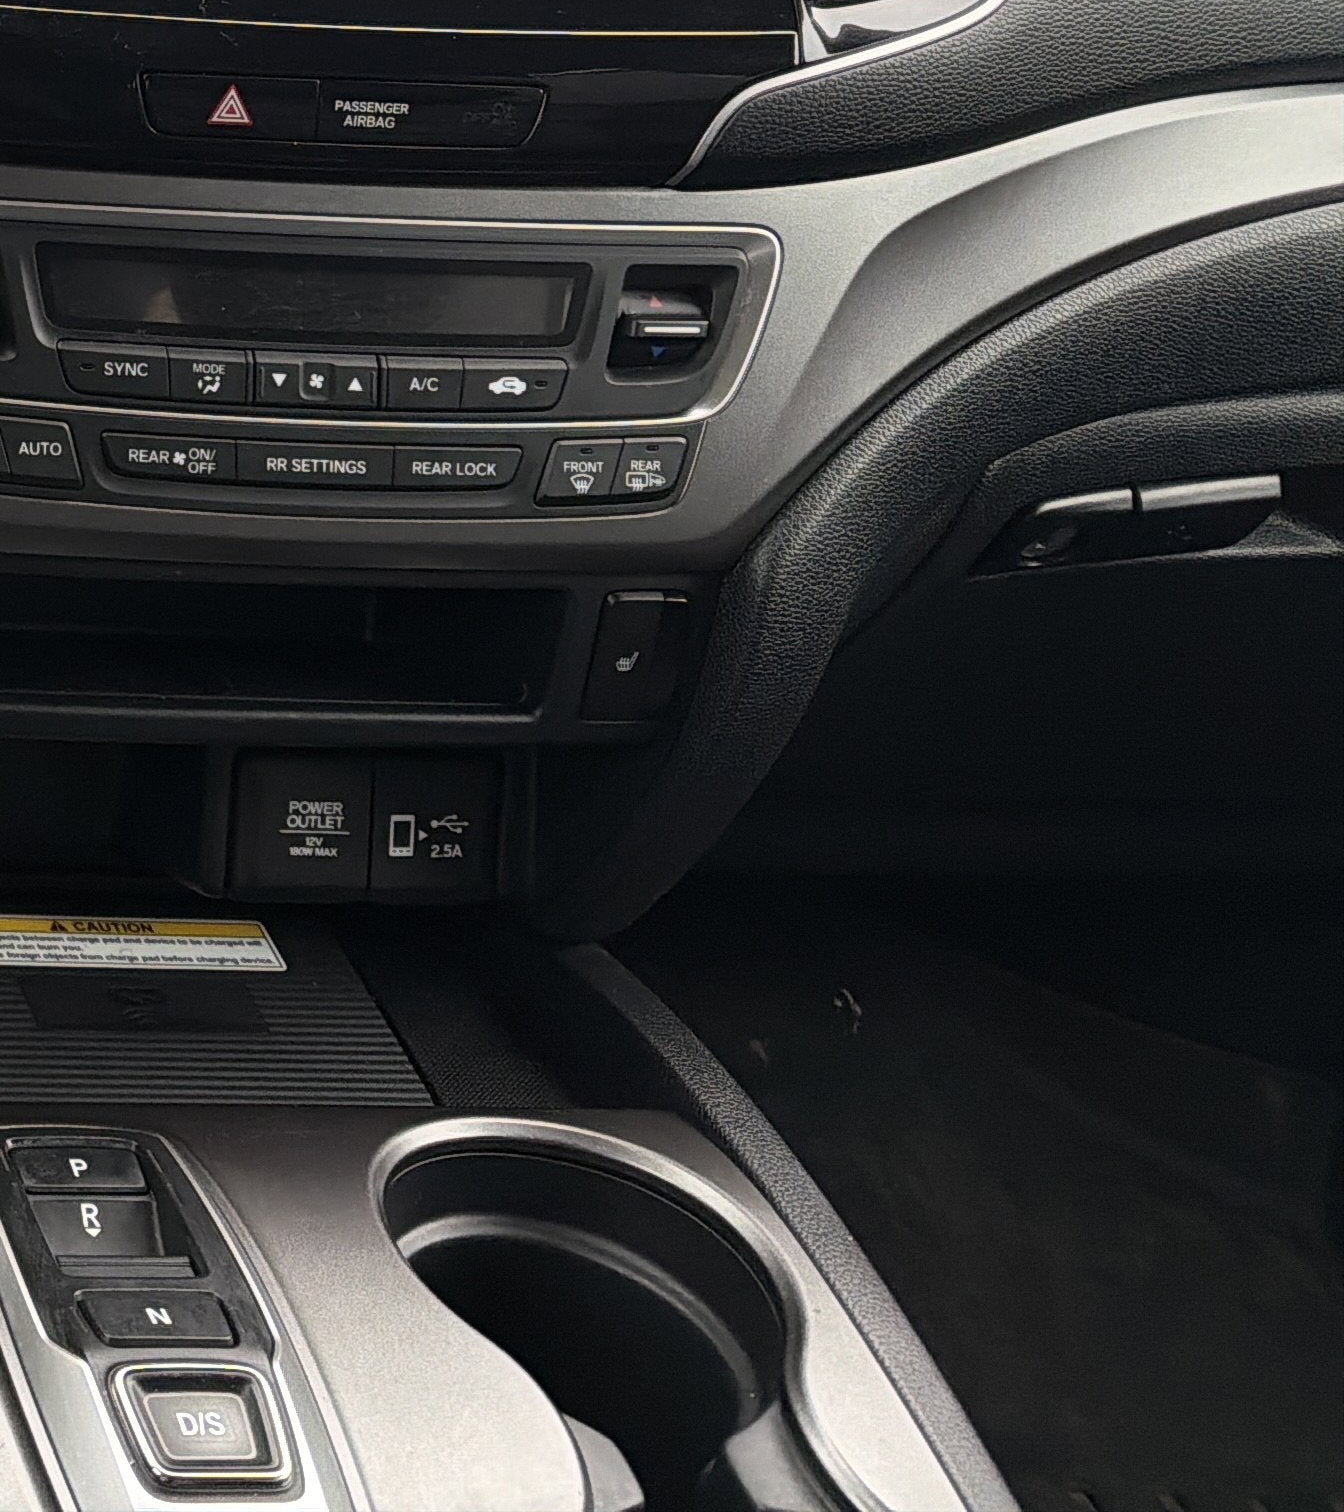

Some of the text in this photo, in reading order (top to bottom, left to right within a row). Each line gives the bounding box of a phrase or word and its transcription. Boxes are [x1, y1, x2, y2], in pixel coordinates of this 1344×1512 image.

[334, 100, 410, 115] PASSENGER
[343, 114, 396, 129] AIRBAG
[103, 361, 149, 377] SYNC
[192, 363, 226, 375] MODE
[409, 377, 439, 392] A/C
[18, 442, 62, 457] AUTO
[128, 447, 216, 464] REAR ON/
[187, 461, 216, 475] OFF
[266, 457, 367, 475] RR SETTINGS
[412, 462, 497, 477] REAR LOCK
[563, 461, 604, 474] FRONT
[630, 460, 661, 472] REAR
[289, 801, 343, 815] POWER
[287, 815, 344, 829] OUTLET
[305, 837, 323, 847] 12V
[289, 846, 338, 857] 180W MAX
[430, 844, 463, 858] 2.5A
[73, 922, 154, 933] CAUTION
[68, 1158, 88, 1177] P
[80, 1202, 101, 1228] R
[145, 1307, 172, 1325] N
[175, 1412, 226, 1436] D/S
